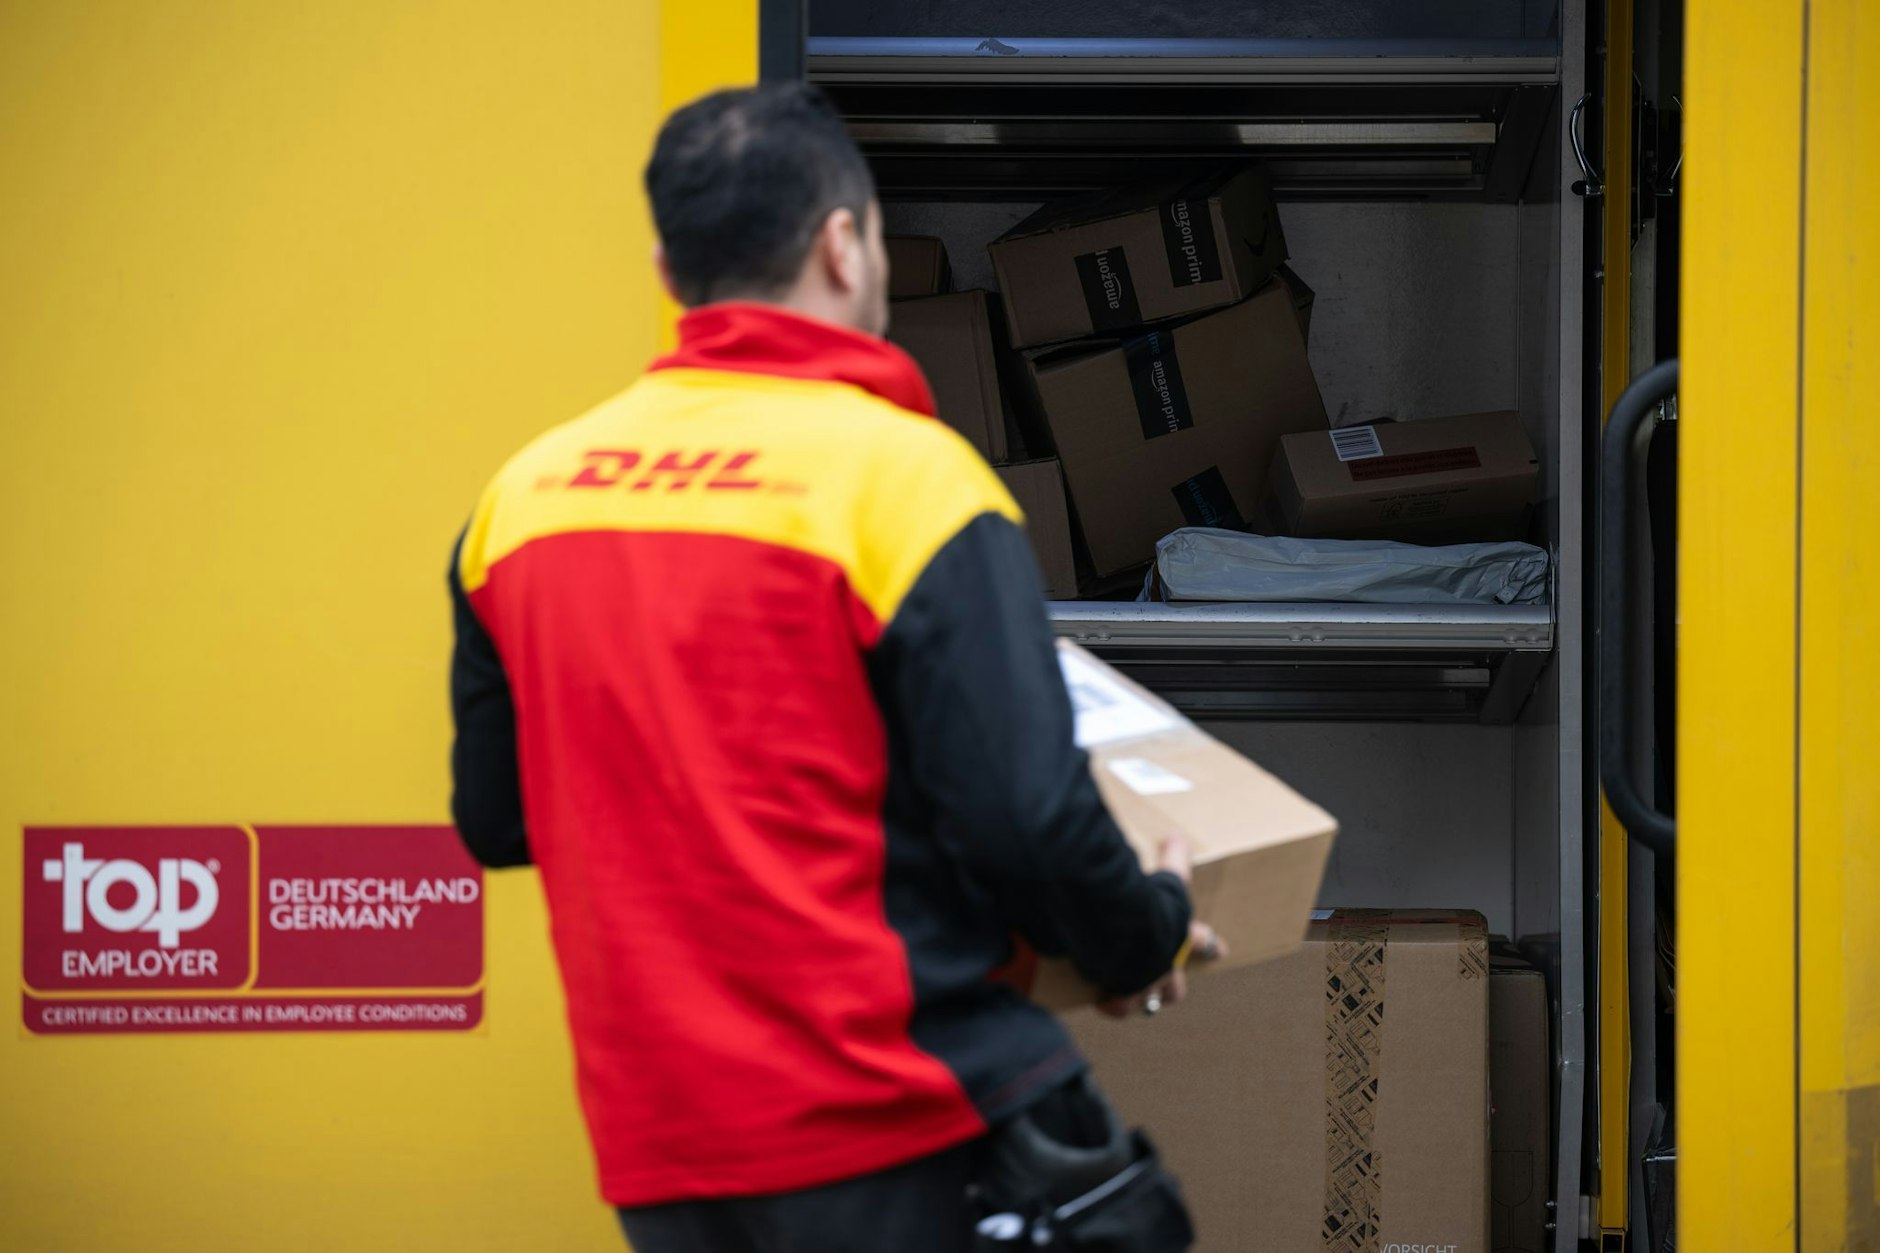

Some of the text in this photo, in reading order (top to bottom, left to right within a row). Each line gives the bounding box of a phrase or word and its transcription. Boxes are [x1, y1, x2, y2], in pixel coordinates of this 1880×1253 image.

[1176, 199, 1203, 283] mazon prim
[1096, 255, 1120, 309] amazon
[1152, 360, 1173, 405] amazon
[568, 450, 762, 489] DHL
[42, 842, 219, 948] top
[269, 878, 478, 904] DEUTSCHLAND
[269, 904, 421, 930] GERMANY
[62, 949, 218, 977] EMPLOYER
[42, 1004, 468, 1025] CERTIFIED EXCELLENCE IN EMPLOYEE CONDITIONS
